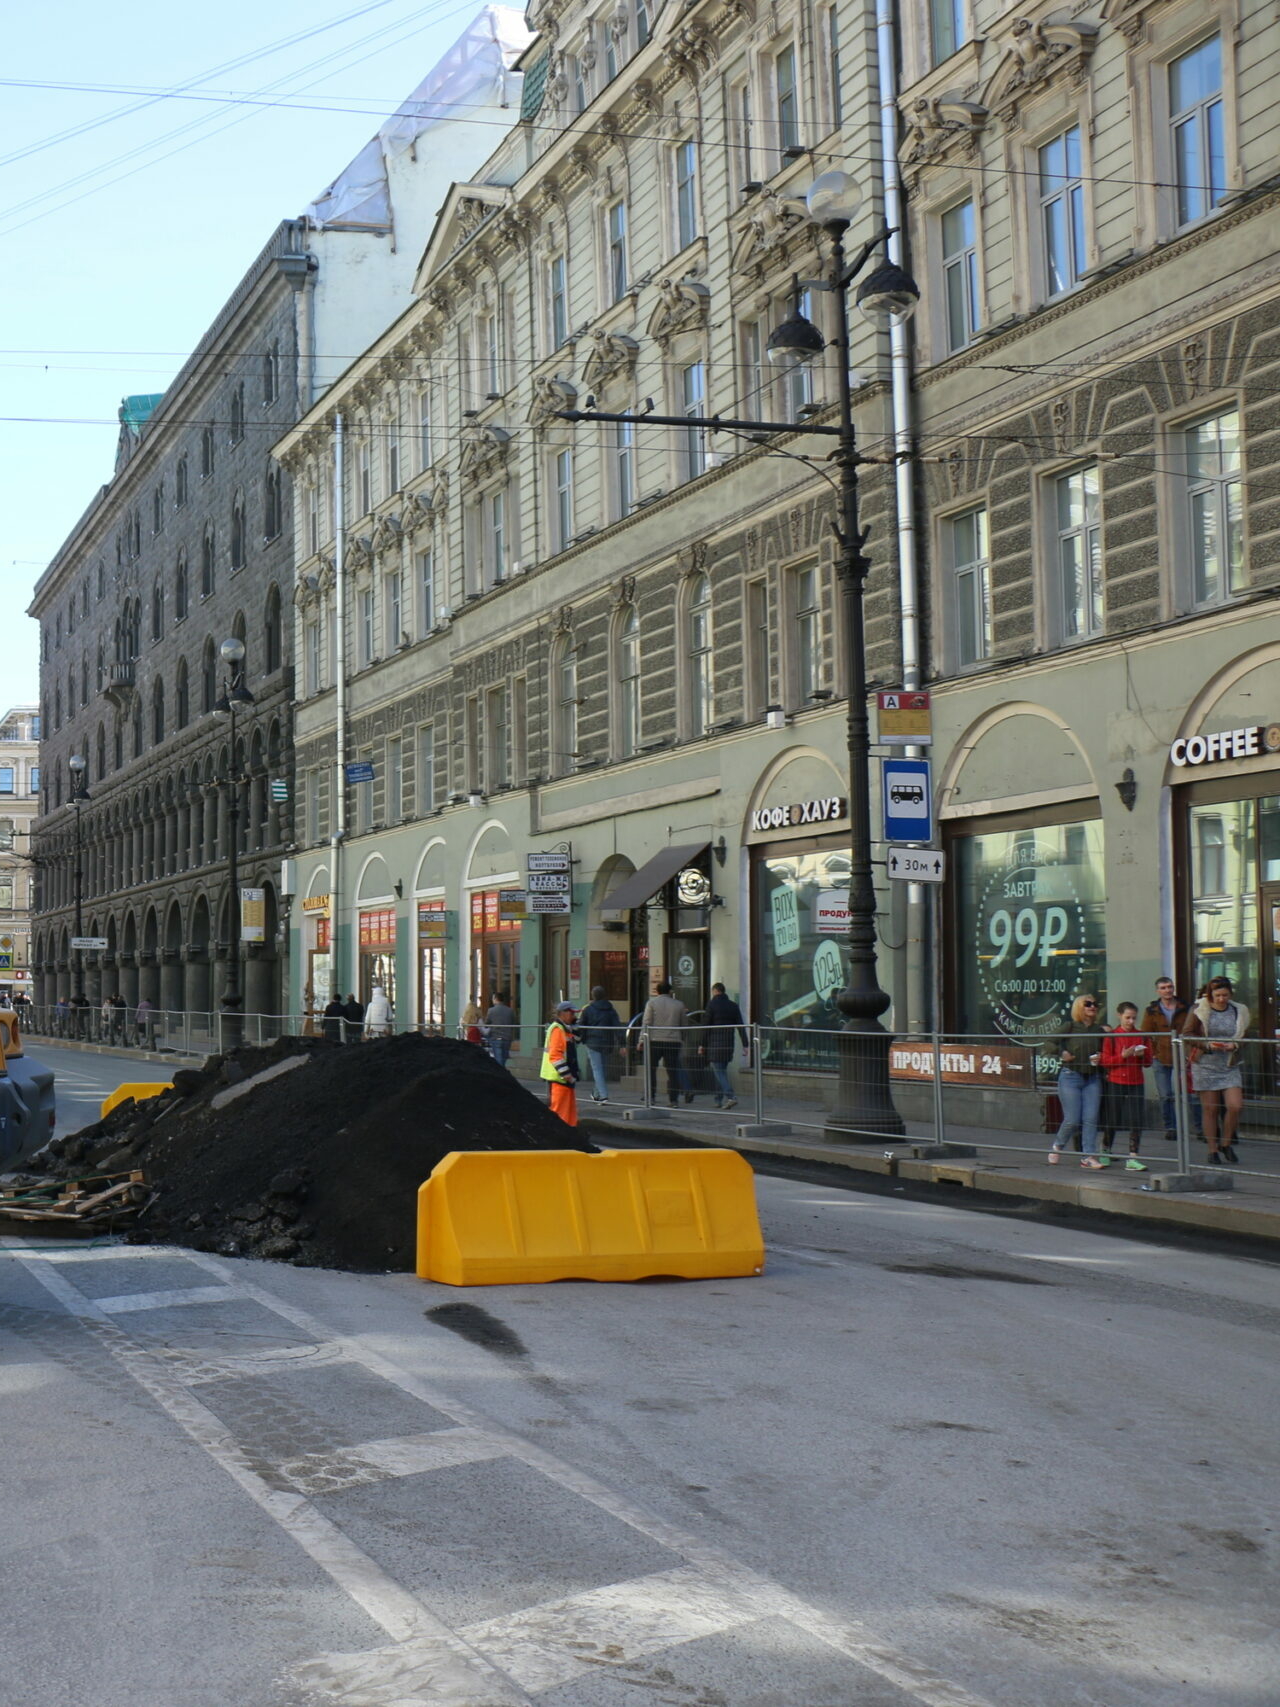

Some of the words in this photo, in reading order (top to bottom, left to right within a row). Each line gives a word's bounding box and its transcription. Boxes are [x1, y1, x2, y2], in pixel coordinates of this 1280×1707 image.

[1171, 726, 1259, 767] COFFEE
[752, 805, 790, 831] КОФЕ
[800, 796, 840, 824] ХАУЗ
[1003, 881, 1054, 898] ЗАВТРАК
[773, 890, 795, 924] BOX
[776, 926, 786, 948] TO
[787, 922, 797, 943] GO
[1001, 980, 1022, 992] 6:00
[1022, 980, 1037, 994] ДО
[1039, 979, 1066, 992] 12:00
[999, 1012, 1036, 1034] КАЖДЫЙ
[1038, 1016, 1062, 1035] ДЕНЬ
[893, 1051, 976, 1075] ПРОДКТЫ
[982, 1054, 1002, 1075] 24
